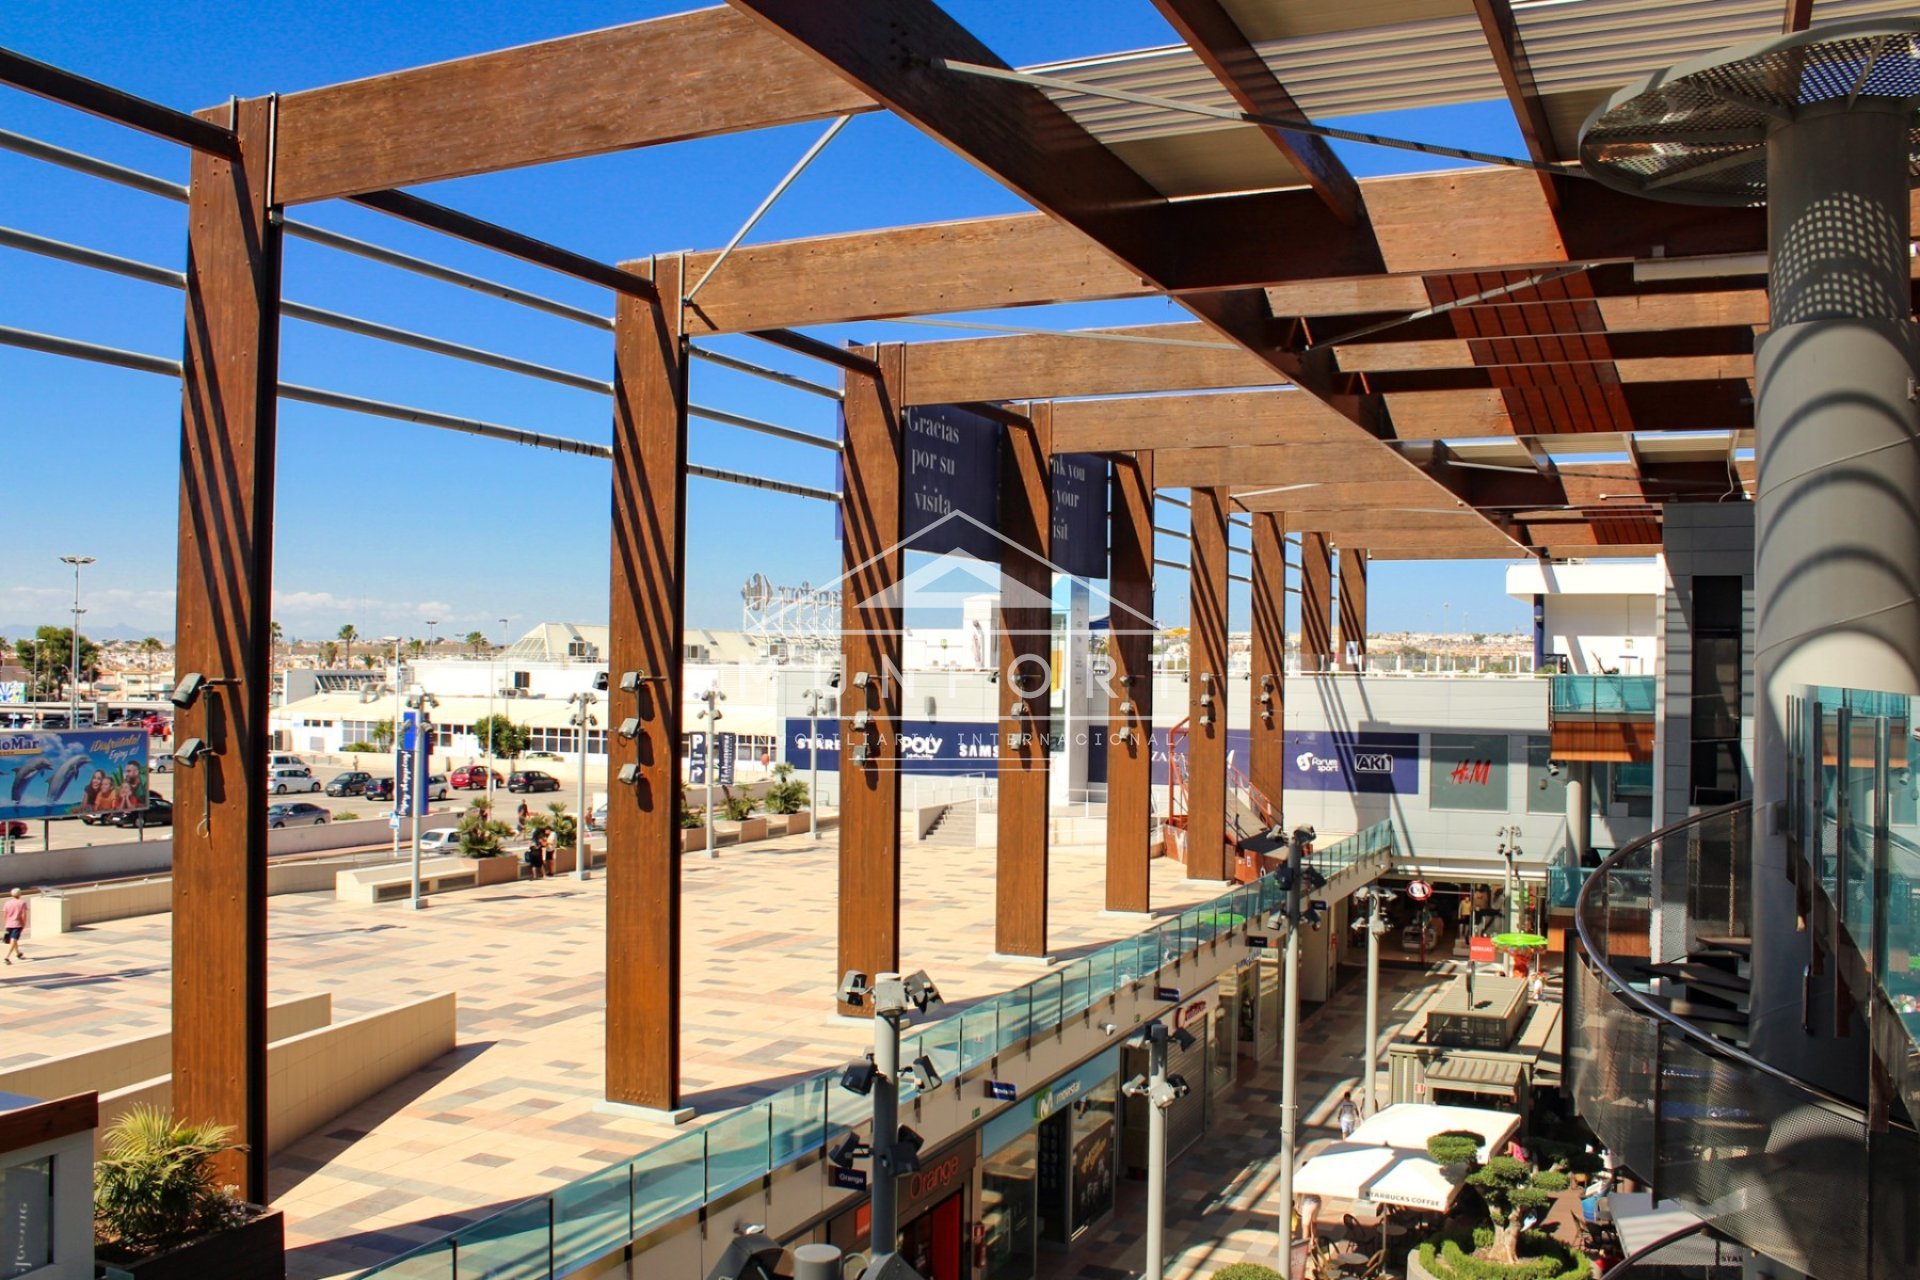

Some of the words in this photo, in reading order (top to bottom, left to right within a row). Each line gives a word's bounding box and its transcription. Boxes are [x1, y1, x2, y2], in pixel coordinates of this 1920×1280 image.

[907, 407, 960, 443] Gracias
[911, 448, 937, 475] por
[939, 457, 956, 476] su
[1068, 463, 1086, 485] you
[914, 485, 951, 515] visita
[1056, 490, 1080, 512] your
[1052, 516, 1069, 540] isit
[0, 736, 40, 751] oMar
[901, 736, 942, 754] POLY
[1451, 759, 1491, 785] H&M
[909, 1155, 960, 1200] Orange
[1365, 1191, 1411, 1203] STARBUCKS
[1412, 1198, 1440, 1208] COFFEE
